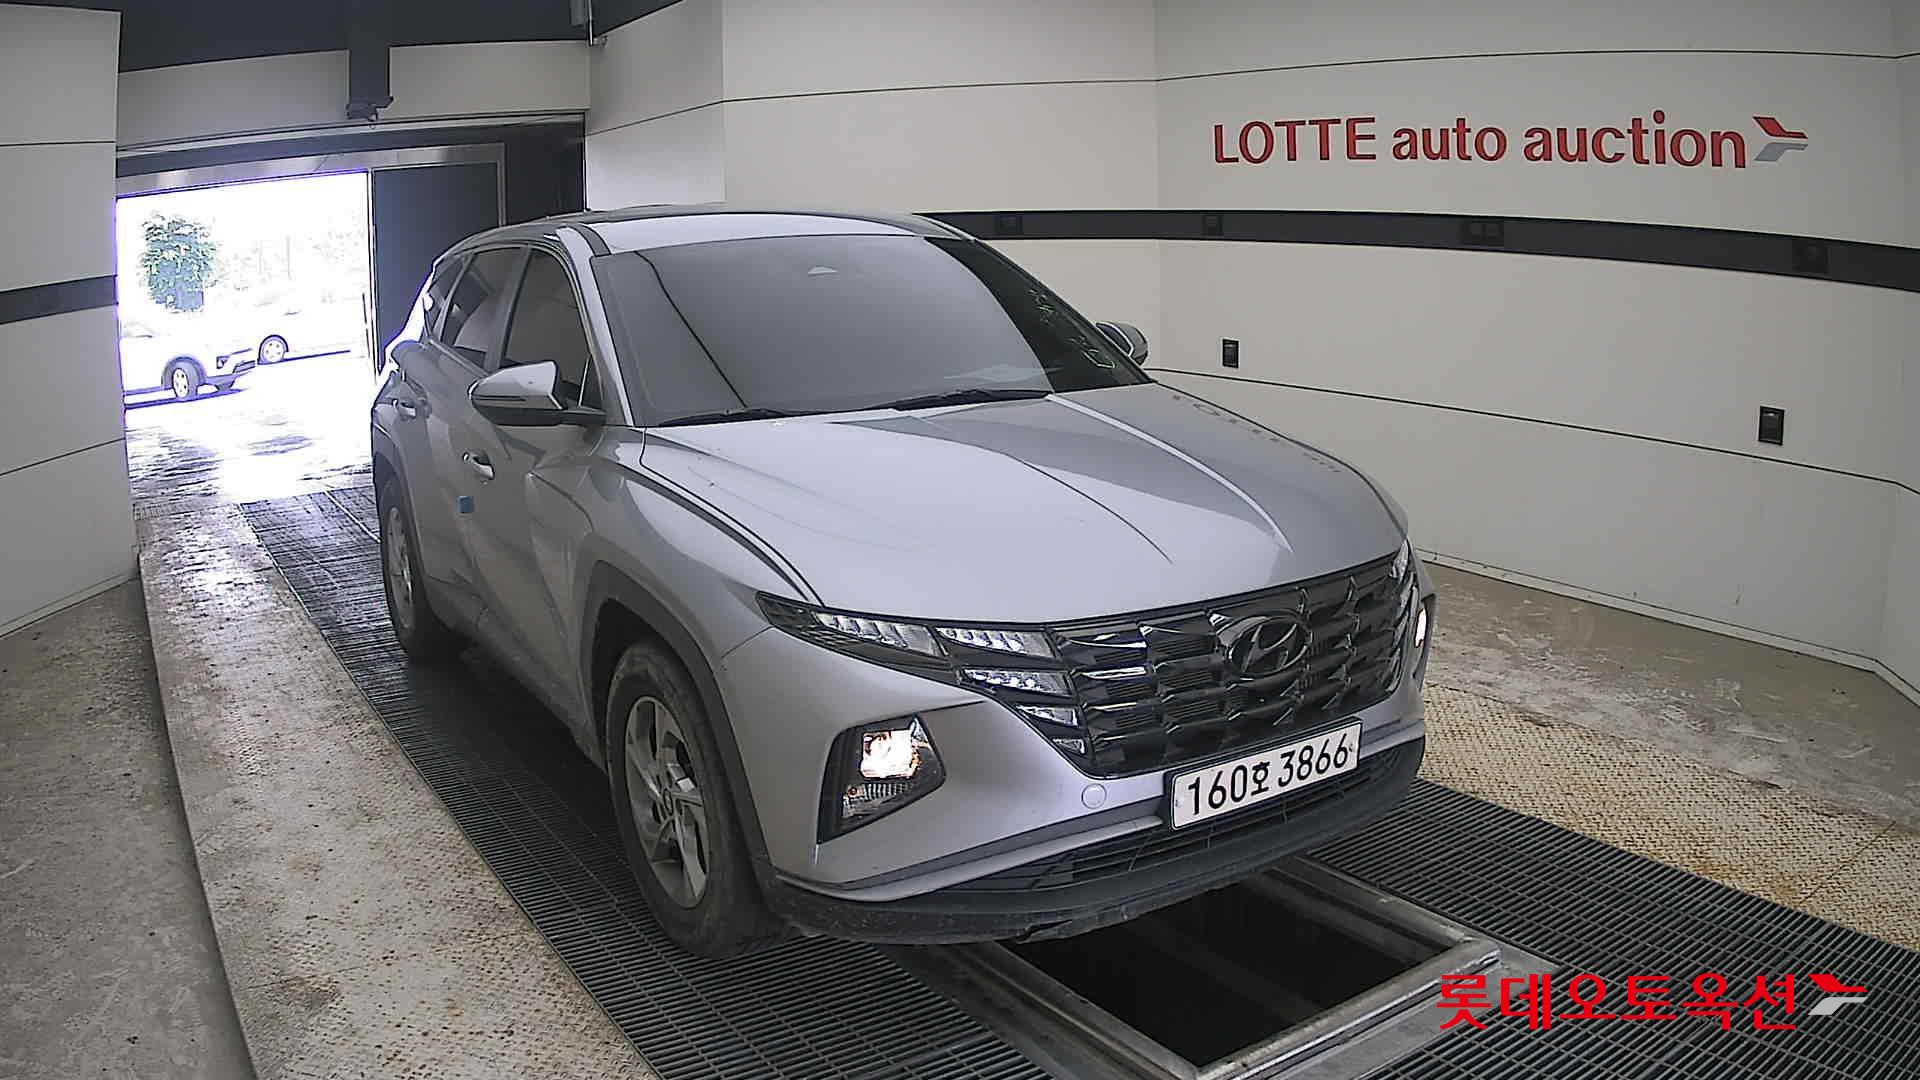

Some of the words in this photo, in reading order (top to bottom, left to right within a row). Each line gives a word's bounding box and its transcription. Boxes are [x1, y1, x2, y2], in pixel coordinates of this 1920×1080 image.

[1213, 116, 1377, 164] LOTTE
[1392, 117, 1508, 162] auto
[1522, 109, 1747, 169] auction
